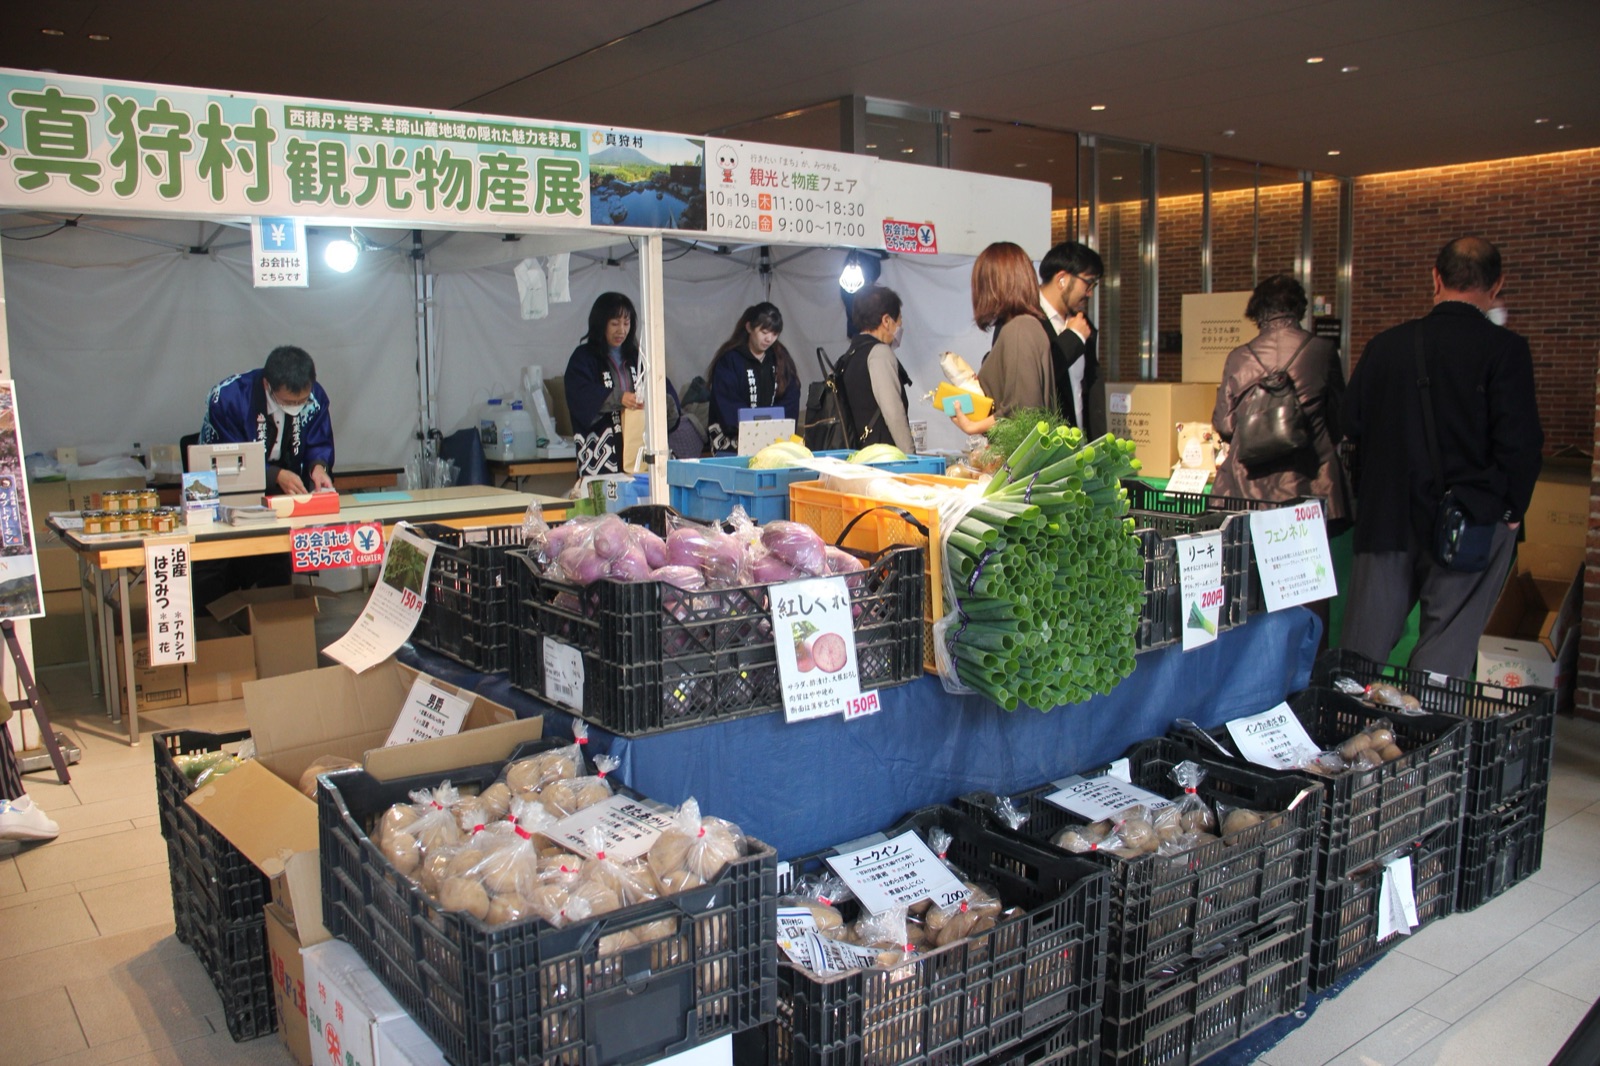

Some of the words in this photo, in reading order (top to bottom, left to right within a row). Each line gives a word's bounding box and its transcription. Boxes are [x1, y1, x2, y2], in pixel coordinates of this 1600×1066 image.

[606, 133, 643, 148] 真狩村
[285, 136, 584, 216] 観光物産展
[749, 167, 858, 194] 観光と物産フェア
[885, 224, 916, 236] お会計は
[886, 237, 917, 249] こちらです
[260, 257, 301, 268] お会計は
[261, 273, 301, 282] こちらです
[1295, 504, 1320, 521] 200円
[295, 531, 350, 549] お会計は
[1265, 523, 1308, 545] フェンネル
[171, 548, 188, 577] 泊産
[296, 549, 352, 567] こちらです
[356, 554, 382, 564] CASHIER
[1188, 543, 1215, 563] リーキ
[154, 556, 169, 609] はちみつ
[401, 588, 423, 613] 150円
[1201, 587, 1223, 609] 200円
[174, 620, 185, 660] アカシア
[846, 692, 878, 716] 150円
[853, 844, 899, 866] メークイン
